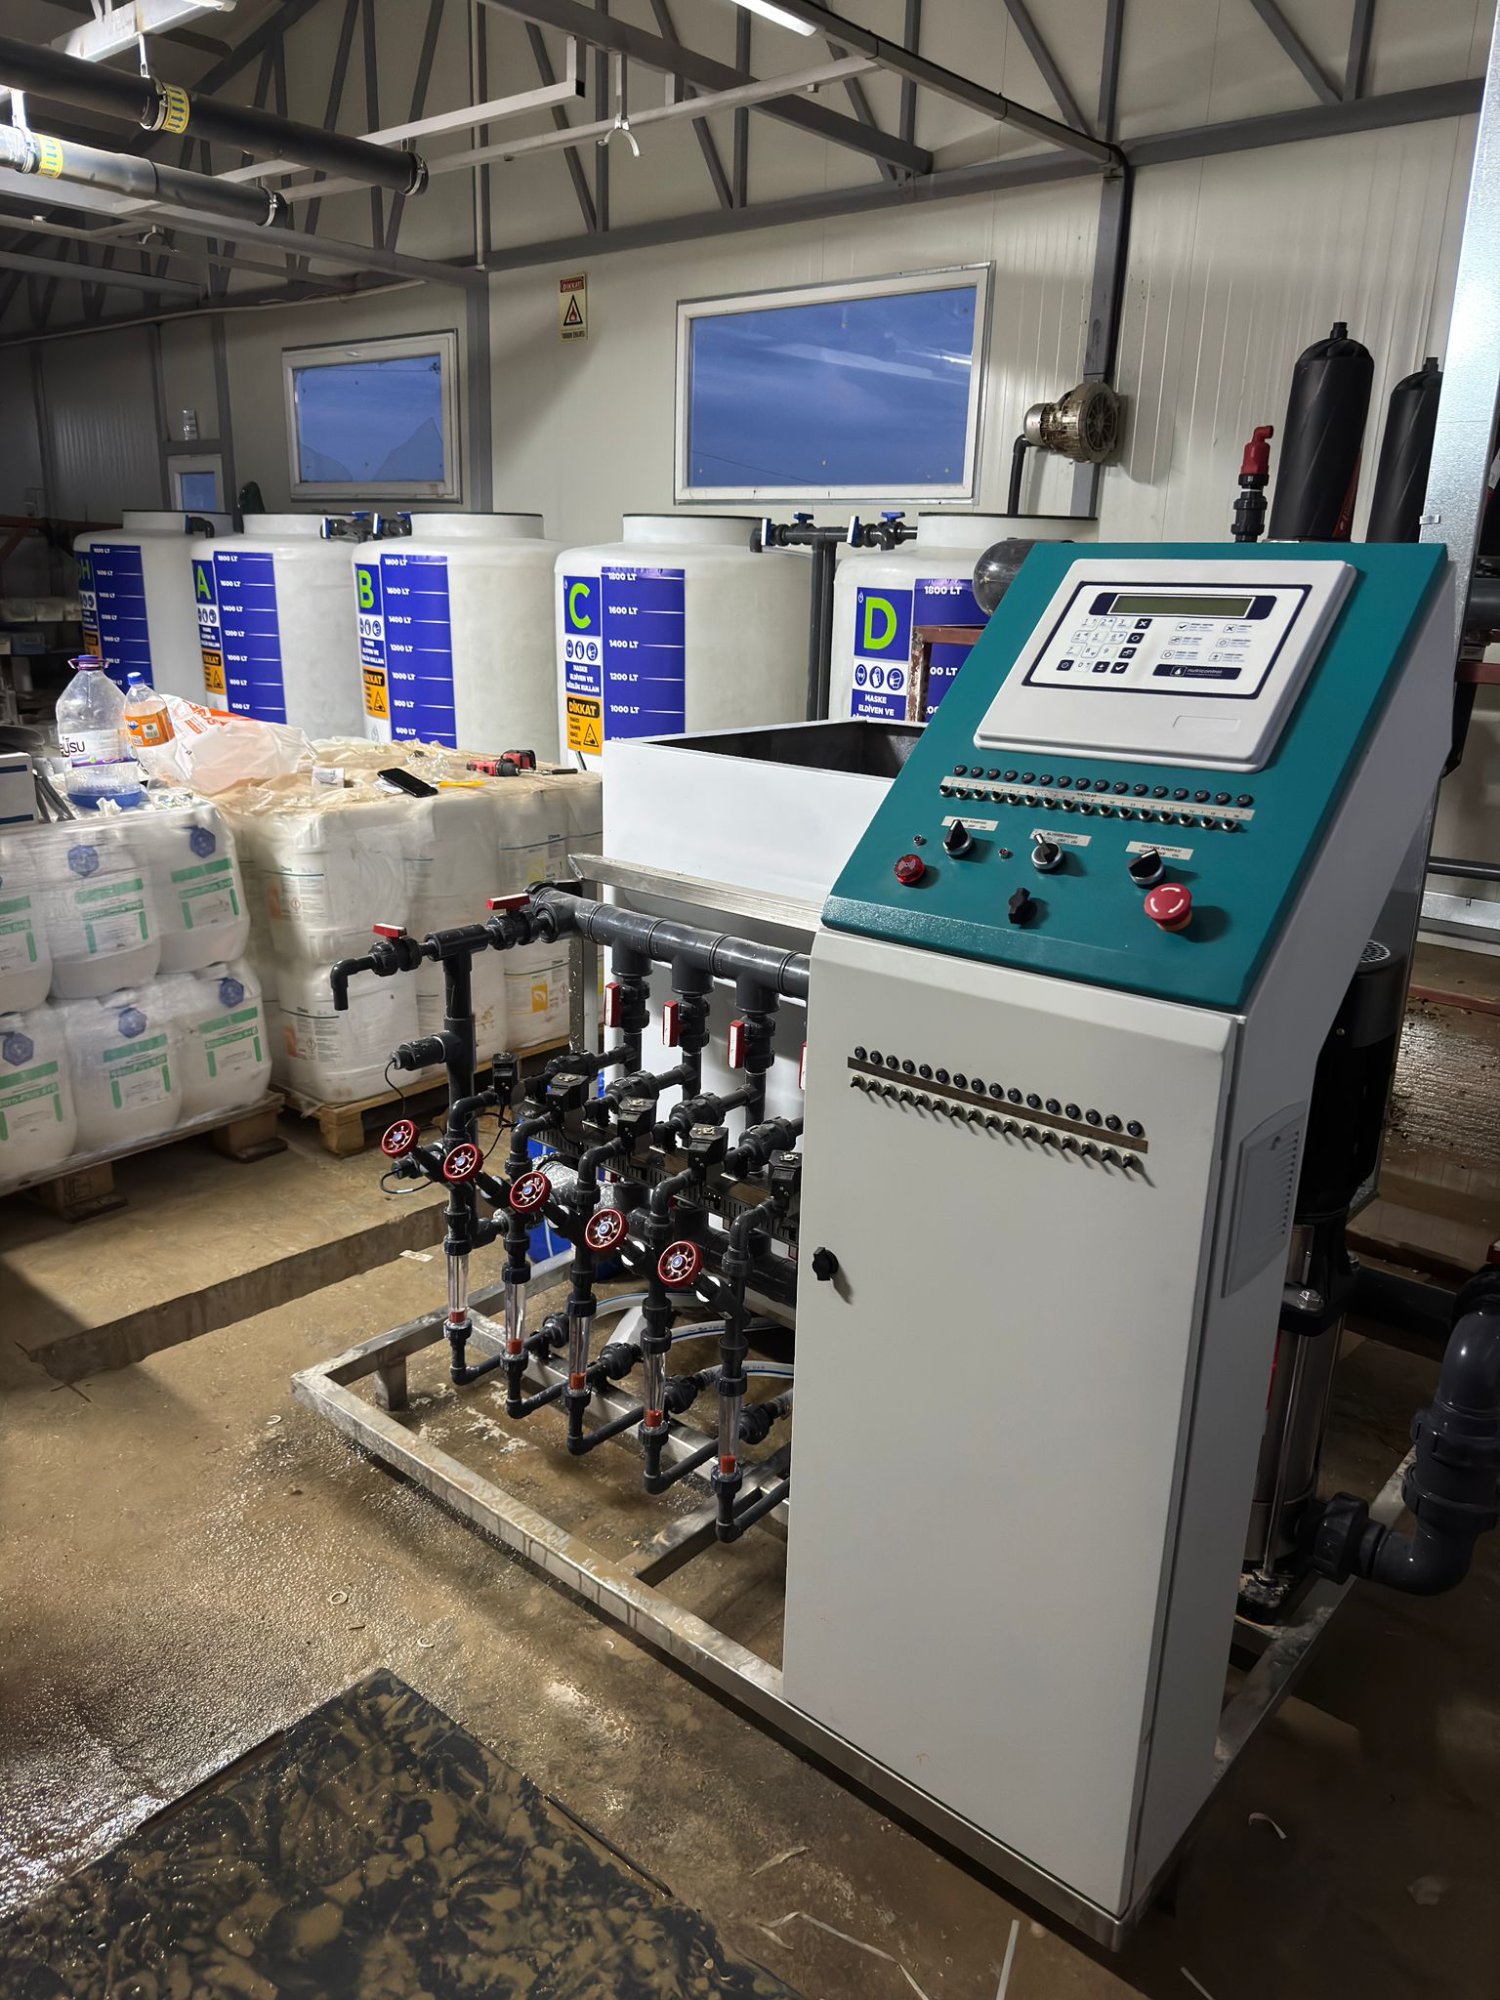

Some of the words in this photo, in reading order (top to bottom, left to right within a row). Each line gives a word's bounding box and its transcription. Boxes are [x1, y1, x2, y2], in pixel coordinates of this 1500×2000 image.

[197, 564, 211, 600] A
[357, 570, 374, 609] B
[924, 586, 949, 594] 1800
[950, 586, 962, 594] LT
[569, 582, 591, 629] C
[863, 596, 897, 650] D
[609, 640, 627, 648] 1400
[930, 667, 943, 675] 00
[610, 673, 627, 681] 1200
[865, 694, 887, 704] MASKE
[569, 700, 596, 716] DİKKAT
[610, 705, 628, 713] 1000
[858, 704, 884, 715] ELDİVEN
[885, 708, 894, 716] VE
